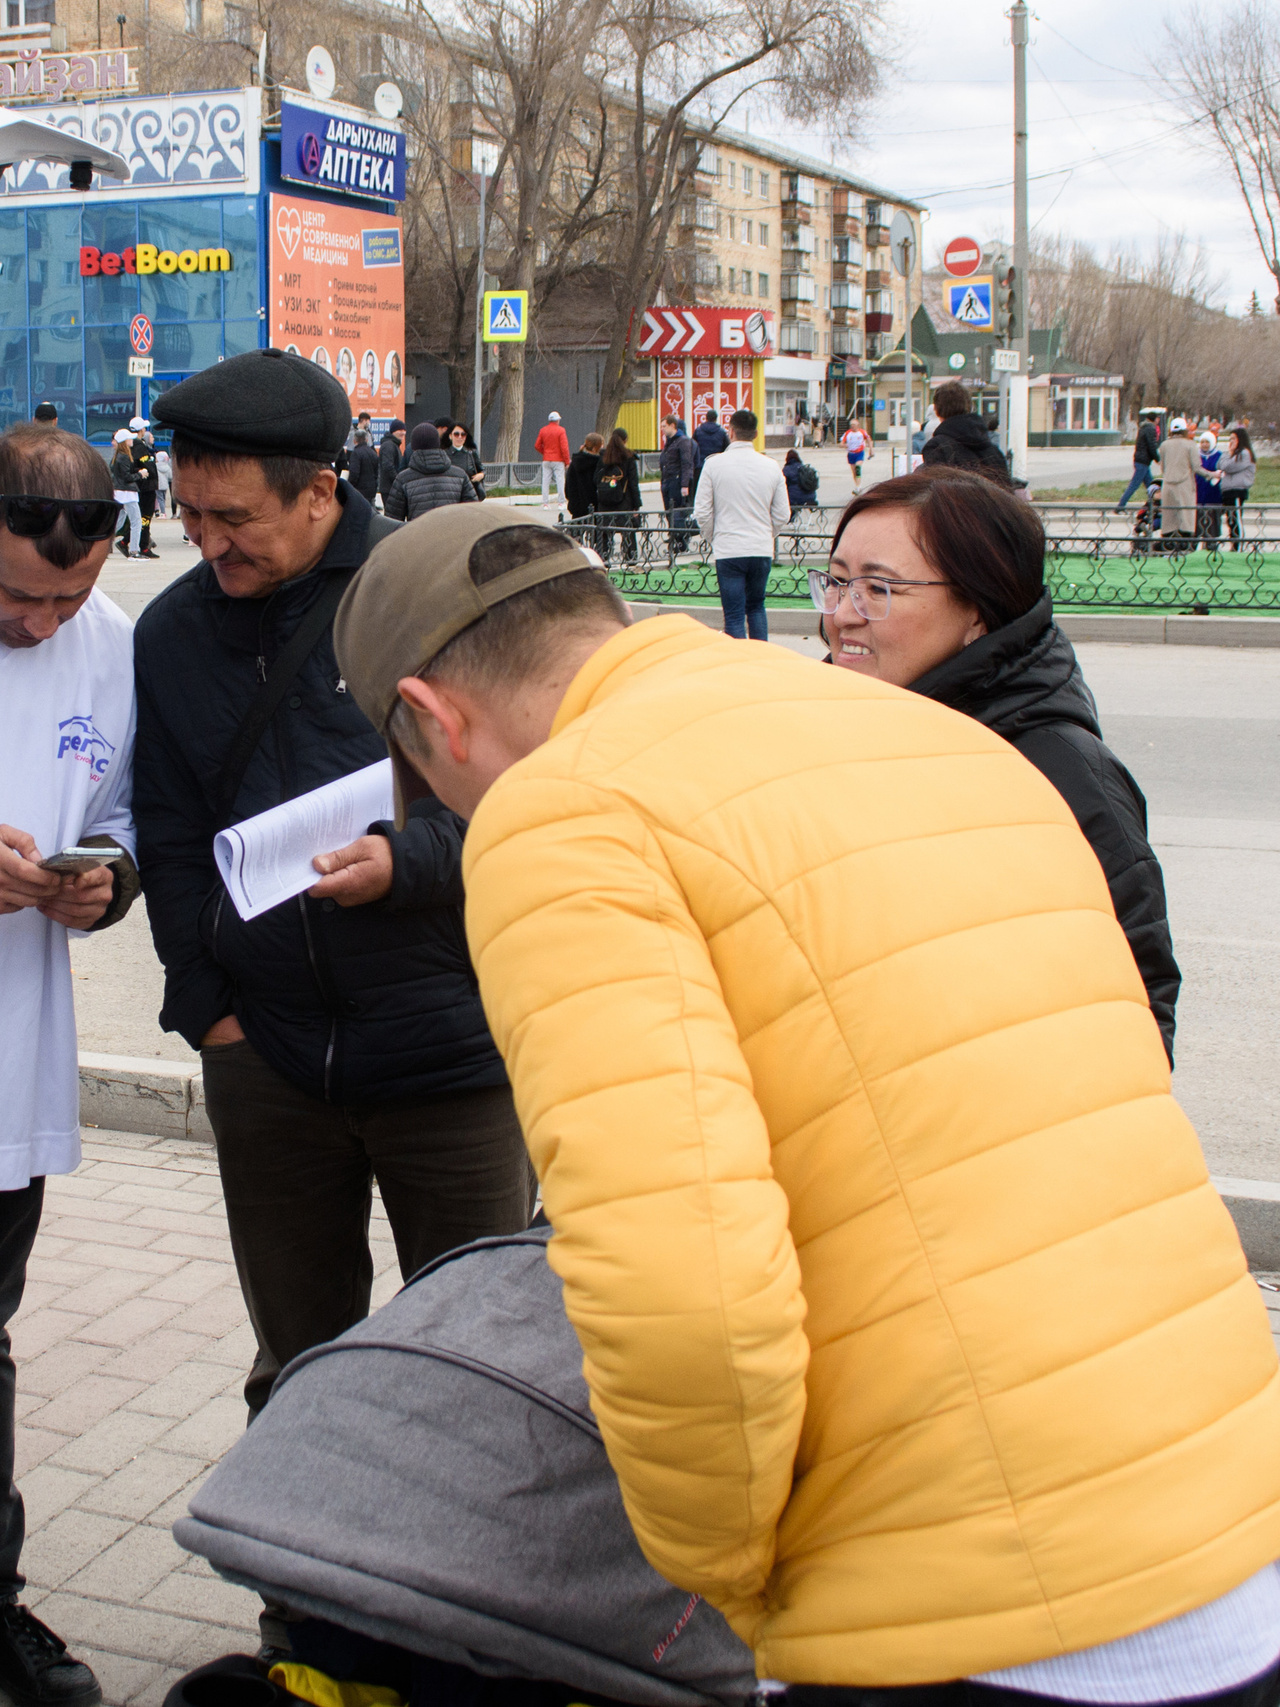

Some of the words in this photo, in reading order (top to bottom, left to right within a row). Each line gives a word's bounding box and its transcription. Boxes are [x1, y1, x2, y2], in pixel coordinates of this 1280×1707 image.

[326, 118, 397, 156] ДАРЫУХАНА
[319, 144, 394, 194] АПТЕКА
[302, 210, 326, 228] ЦЕНТР
[302, 228, 360, 251] СОВРЕМЕННОЙ
[80, 243, 230, 276] BetBoom
[303, 246, 349, 266] МЕДИЦИНЫ
[284, 272, 301, 288] МРТ
[333, 278, 355, 291] Прием
[355, 282, 377, 294] врачей
[333, 294, 377, 310] Процедурный
[377, 299, 402, 312] кабинет
[333, 310, 372, 324] Физкабинет
[284, 320, 323, 336] Анализы
[333, 326, 362, 339] Массаж
